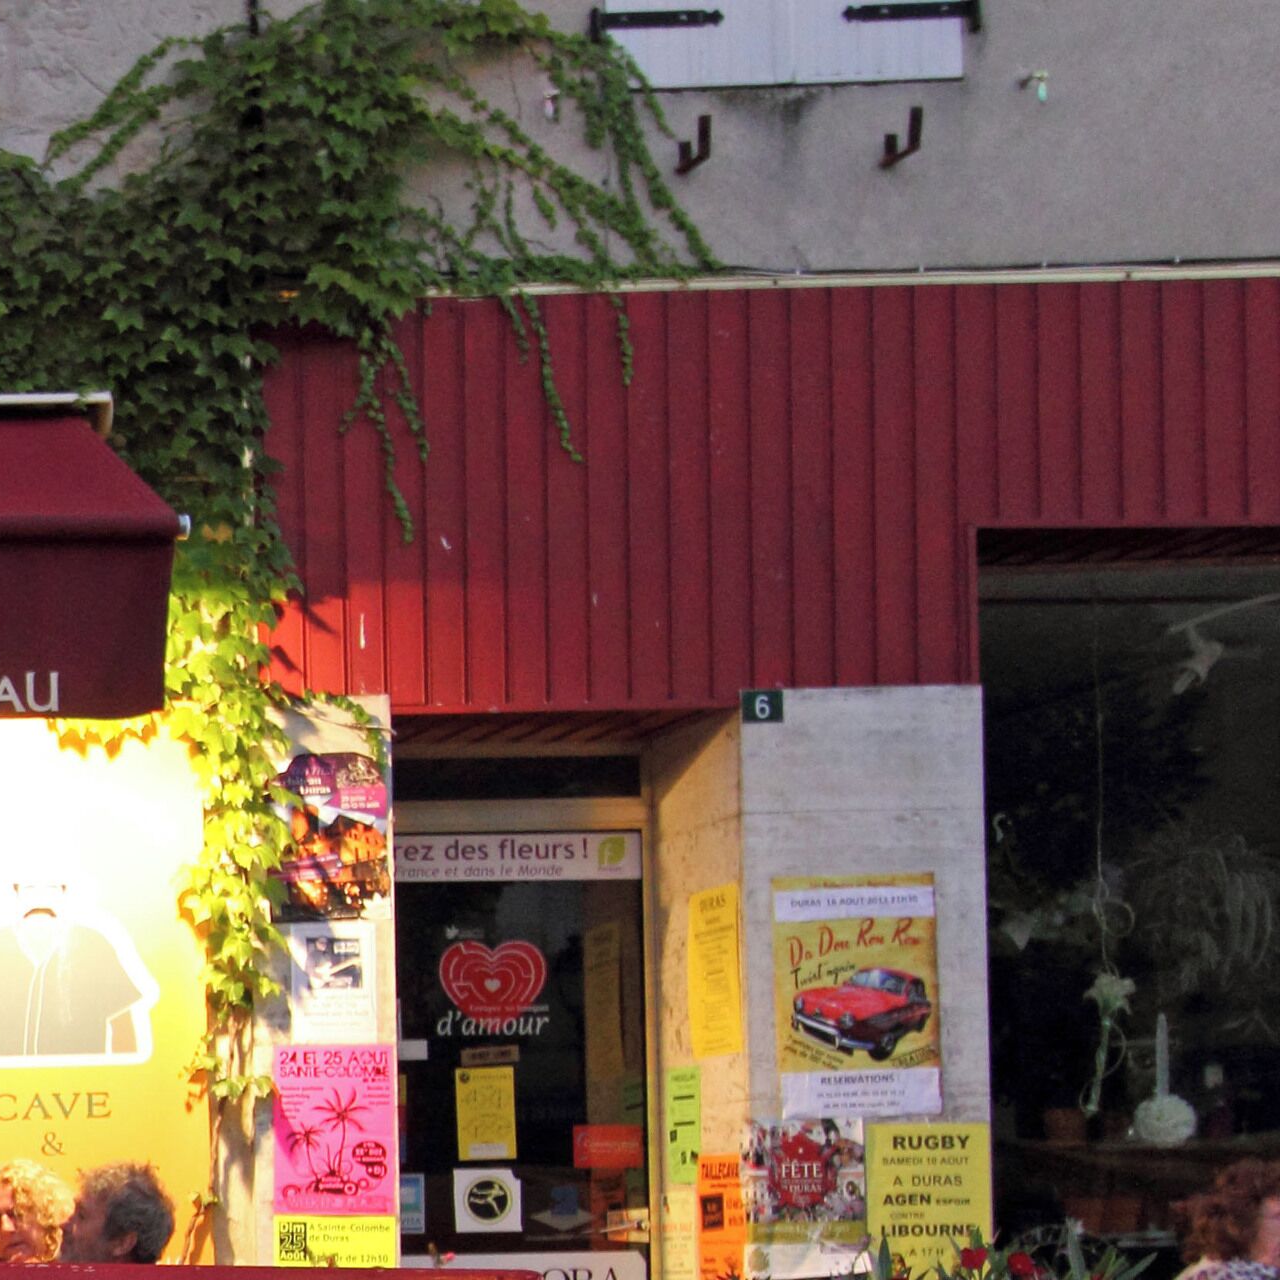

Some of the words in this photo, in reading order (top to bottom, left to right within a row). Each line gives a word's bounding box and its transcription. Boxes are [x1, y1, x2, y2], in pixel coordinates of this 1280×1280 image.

[755, 695, 769, 719] 6
[394, 843, 435, 861] rez
[444, 839, 488, 861] des
[499, 838, 575, 861] fleurs
[445, 866, 458, 877] et
[464, 865, 495, 878] dans
[500, 864, 513, 877] le
[518, 864, 563, 878] Monde
[437, 1010, 550, 1036] d'amour
[280, 1051, 297, 1065] 24
[303, 1051, 317, 1065] ET
[323, 1051, 343, 1065] 25
[348, 1050, 388, 1065] AOUT
[820, 1074, 895, 1085] RESERVATIONS
[41, 1131, 66, 1156] &
[893, 1135, 970, 1150] RUGBY
[782, 1159, 824, 1178] FÊTE
[882, 1156, 923, 1166] SAMEDI
[893, 1175, 904, 1187] A
[912, 1175, 963, 1187] DURAS
[883, 1194, 932, 1206] AGEN
[317, 1222, 347, 1232] Sainte
[279, 1233, 306, 1250] 25
[323, 1233, 350, 1243] Duras
